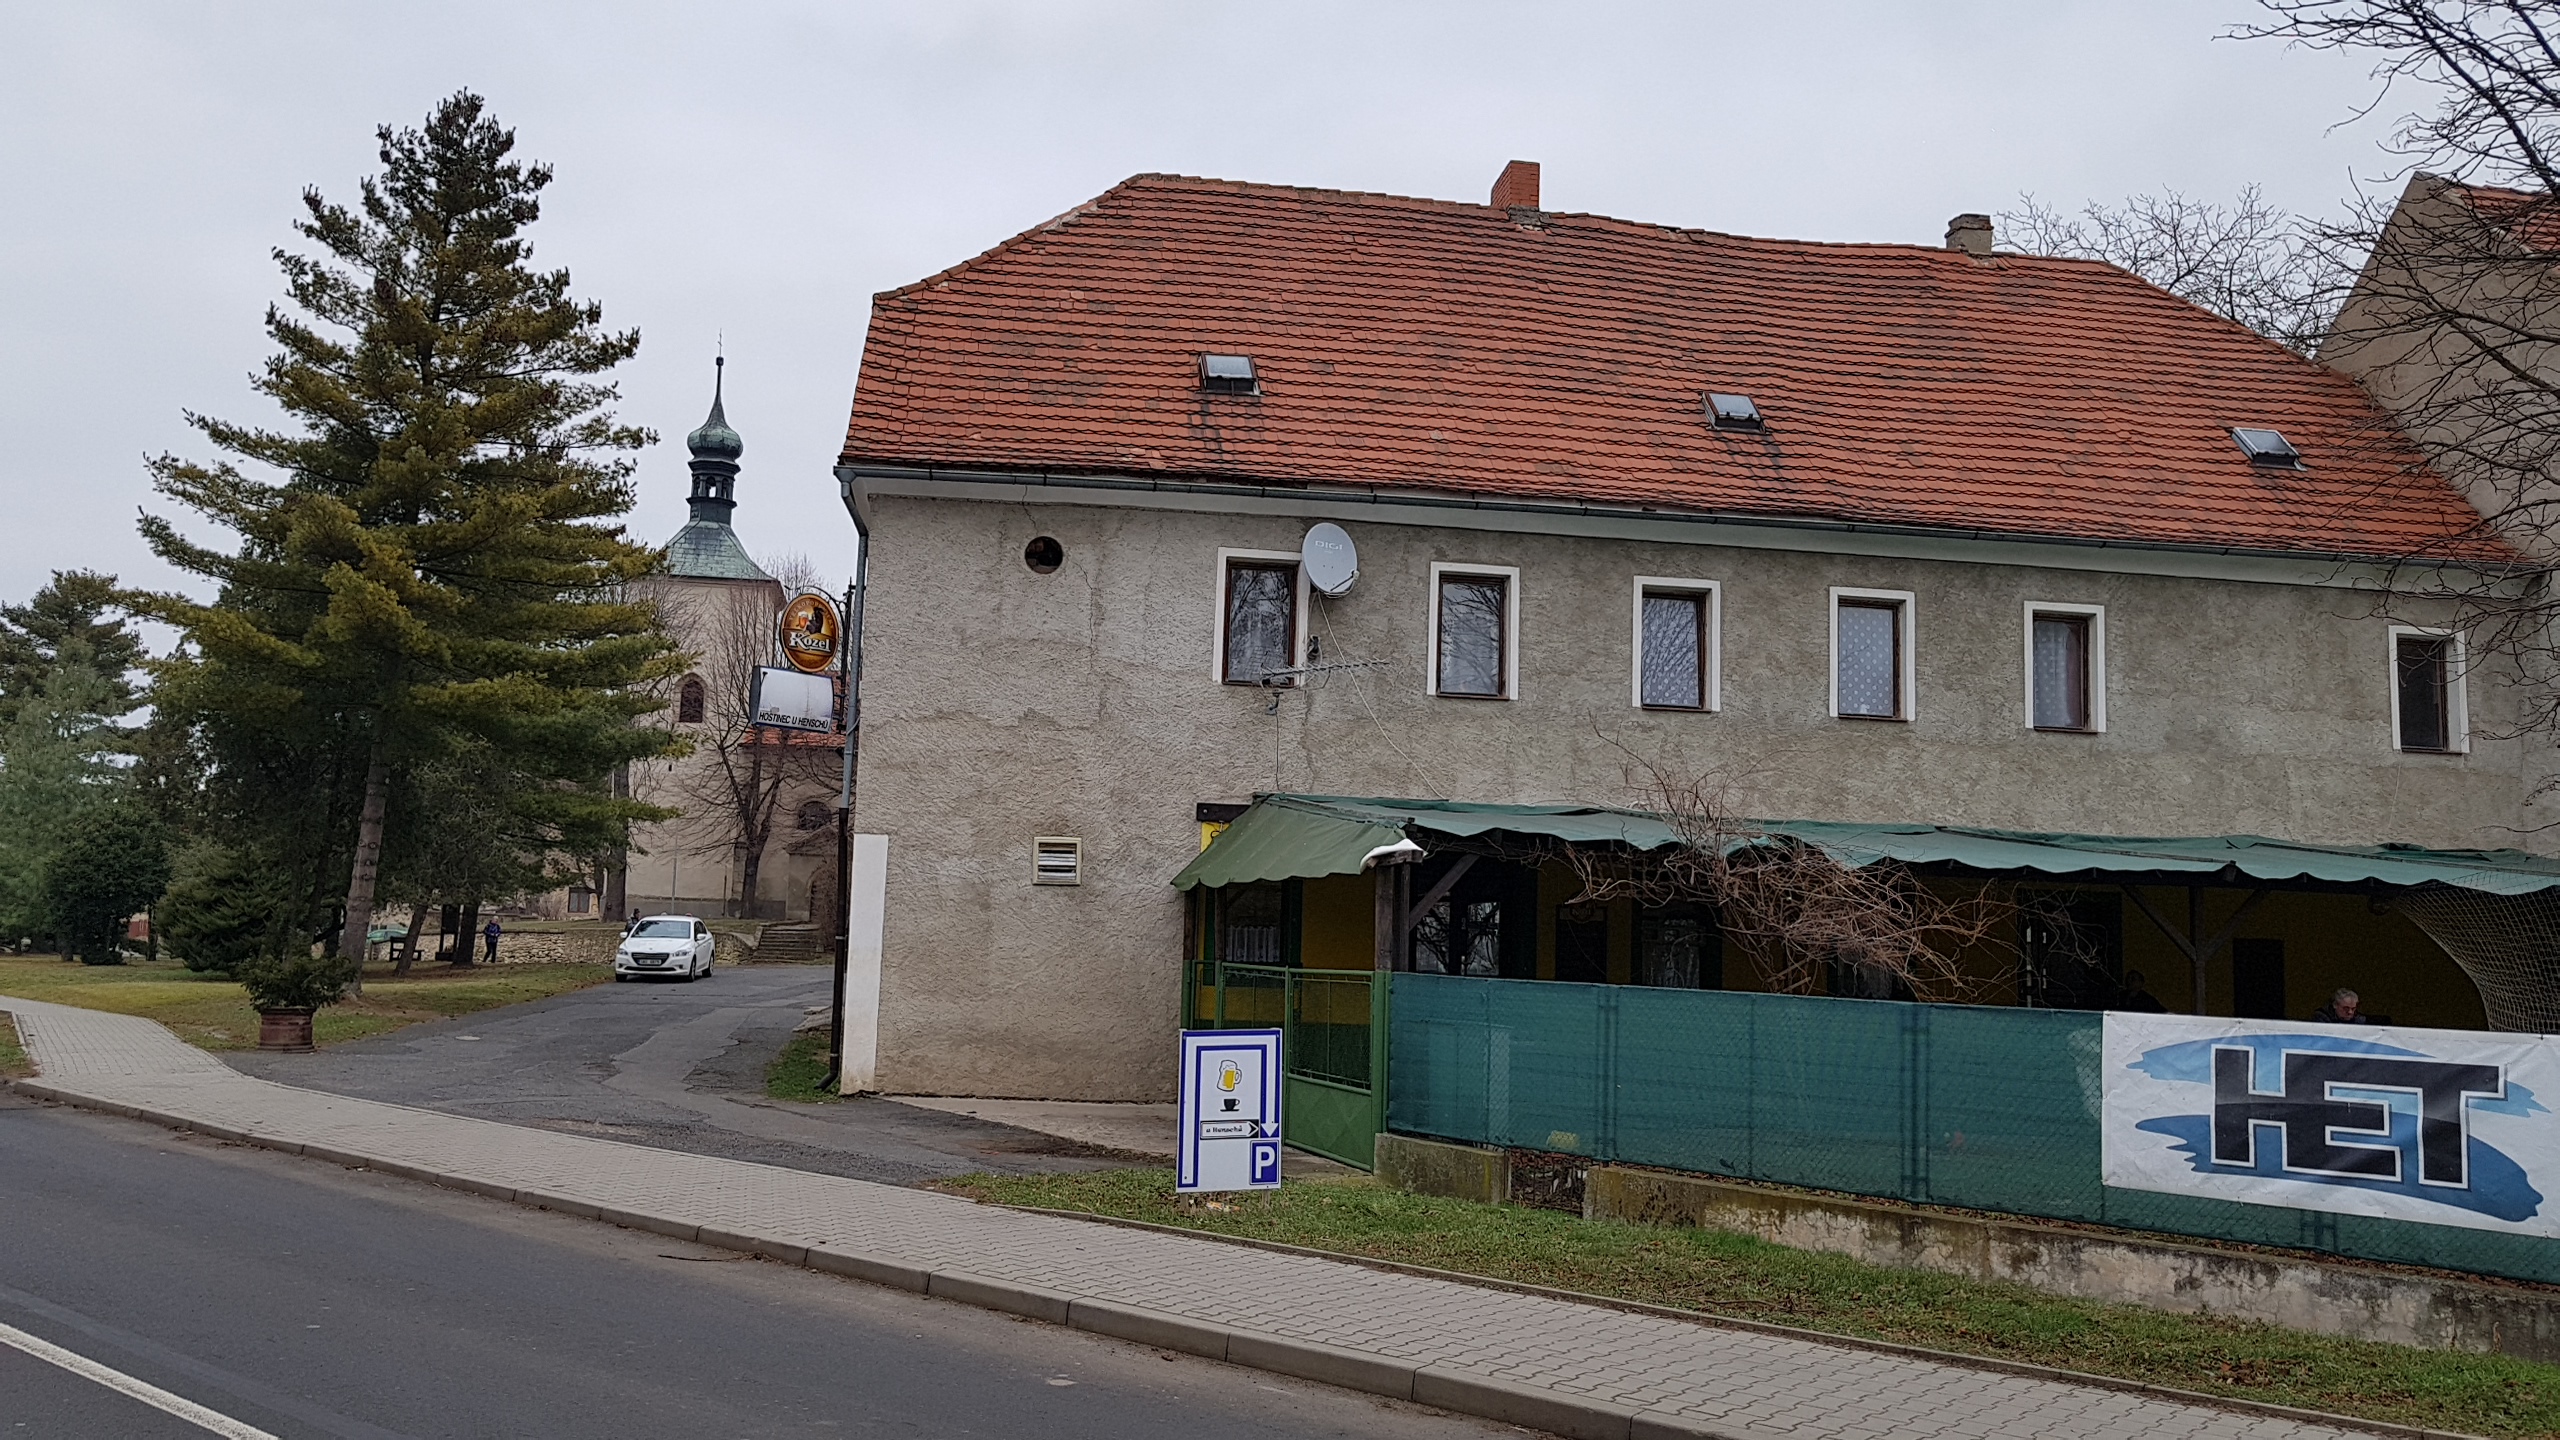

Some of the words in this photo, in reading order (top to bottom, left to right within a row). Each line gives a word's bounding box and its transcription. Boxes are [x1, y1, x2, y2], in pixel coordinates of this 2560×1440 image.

[1315, 540, 1343, 550] DIGI
[789, 631, 832, 652] Kozel
[758, 711, 791, 724] HOSTINEC
[791, 716, 798, 725] U
[2211, 1044, 2506, 1189] HET
[1255, 1145, 1275, 1179] P
